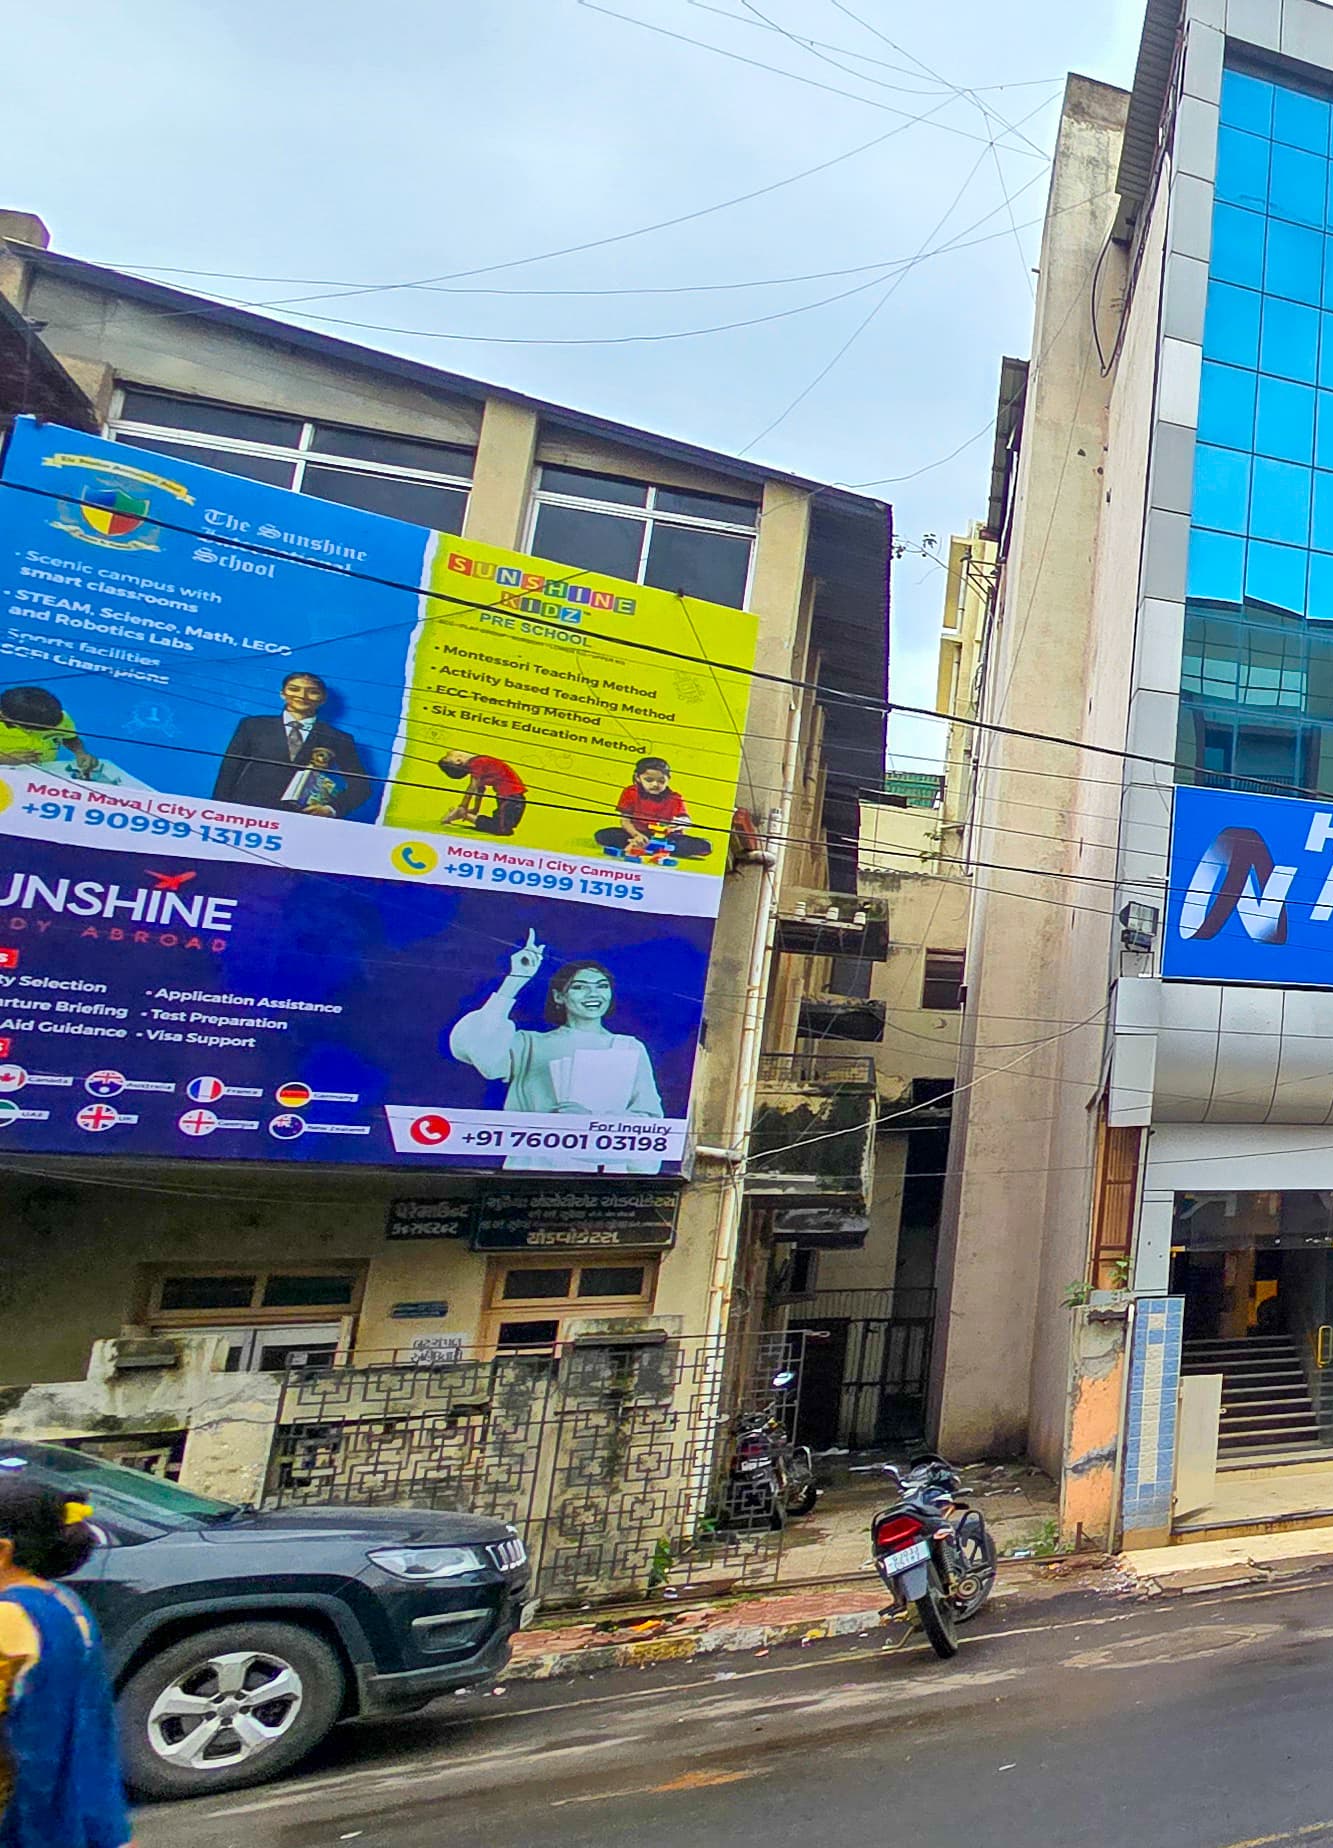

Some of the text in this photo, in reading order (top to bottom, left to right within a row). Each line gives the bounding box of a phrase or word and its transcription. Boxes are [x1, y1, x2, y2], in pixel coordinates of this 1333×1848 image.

[204, 508, 251, 533] The
[256, 523, 368, 562] Sunshine
[25, 550, 222, 604] Scenic campus with
[192, 547, 277, 579] School
[20, 565, 199, 614] smart classrooms
[450, 555, 635, 614] SUNSHINE
[502, 592, 581, 623] KIDZ
[9, 605, 195, 652] and Robotics Labs
[479, 612, 517, 631] PRE
[520, 623, 593, 648] SCHOOL
[80, 642, 161, 667] facilities
[242, 637, 293, 657] LEGO
[53, 654, 170, 685] Champions
[443, 644, 530, 672] Montessori
[533, 663, 600, 689] Teaching
[603, 679, 658, 700] Method
[435, 684, 602, 727] ECC Teaching Method
[439, 664, 676, 723] Activity based Teaching Method
[431, 703, 647, 756] Six Bricks Education Method
[26, 782, 82, 802] Mota
[87, 791, 142, 811] Mava
[156, 802, 198, 821] City
[200, 809, 281, 832] Campus
[22, 800, 283, 853] +91 90999 13195
[447, 845, 490, 862] Mota
[493, 852, 535, 869] Mava
[546, 859, 578, 875] City
[580, 865, 642, 883] Campus
[444, 862, 645, 902] +91 90999 13195
[80, 926, 228, 953] ABROAD
[18, 975, 108, 994] Selection
[155, 987, 344, 1015] Application Assistance
[55, 1000, 129, 1019] Briefing
[150, 1008, 289, 1032] Test Preparation
[0, 1018, 128, 1039] Aid Guidance
[146, 1028, 257, 1049] Visa Support
[461, 1130, 668, 1152] +91 76001 03198
[589, 1121, 672, 1136] For Inquiry
